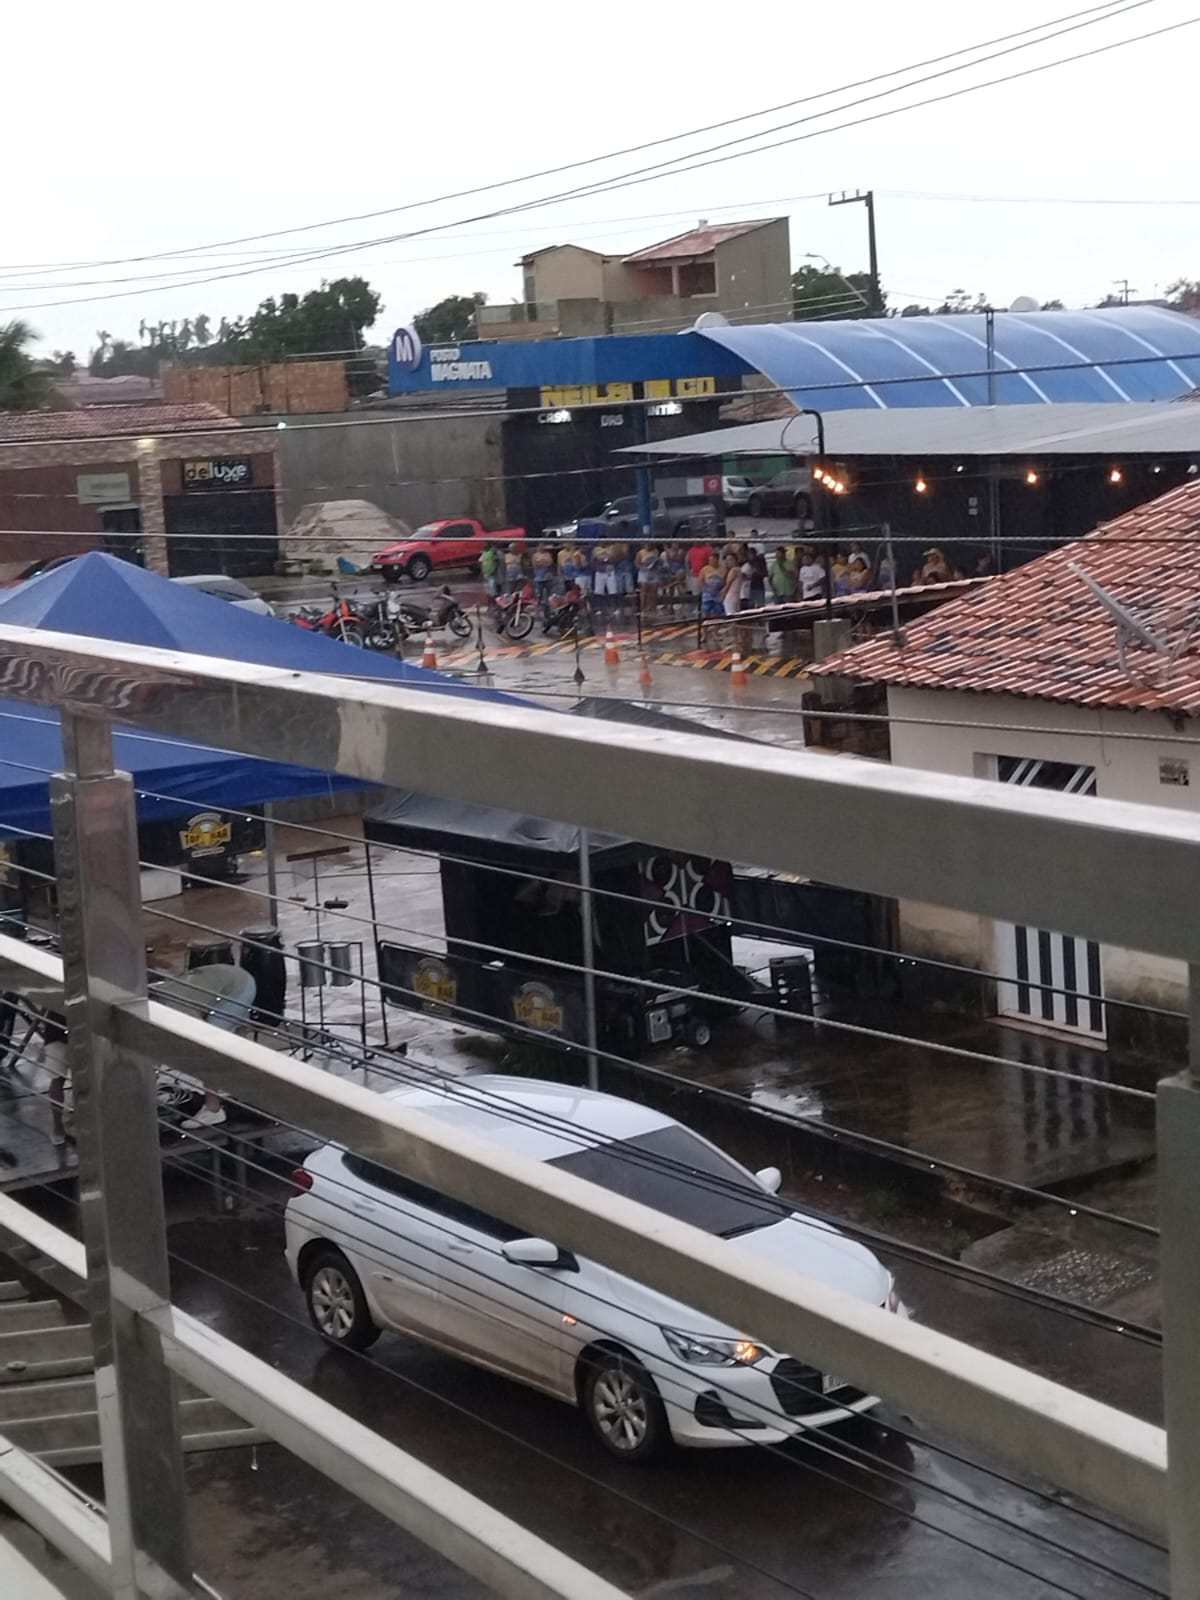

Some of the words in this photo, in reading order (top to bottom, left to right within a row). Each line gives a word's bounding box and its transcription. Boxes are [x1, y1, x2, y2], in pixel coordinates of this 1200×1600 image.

[431, 362, 493, 381] MAGNATA
[601, 414, 624, 427] DAS
[187, 462, 248, 482] deluxe
